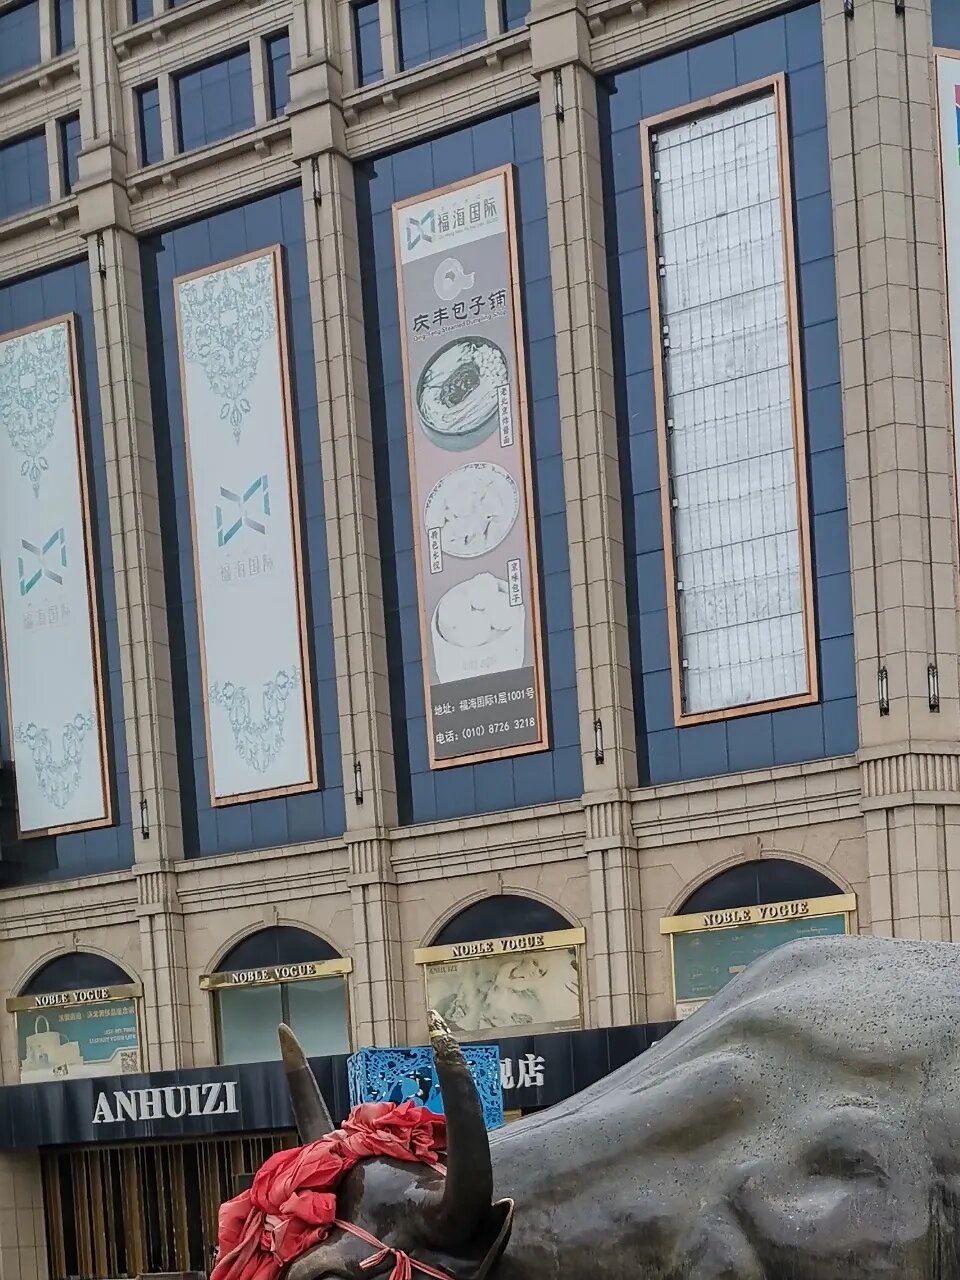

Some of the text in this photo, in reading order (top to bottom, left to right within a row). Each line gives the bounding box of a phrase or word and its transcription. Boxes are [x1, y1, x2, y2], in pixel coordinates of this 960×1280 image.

[438, 197, 497, 233] 福海国际
[413, 289, 506, 333] 庆丰包子铺
[488, 721, 510, 734] 8726
[514, 717, 535, 730] 3218
[703, 901, 809, 927] NOBLE VOGUE
[452, 935, 544, 957] NOBLE VOGUE
[232, 963, 317, 983] NOBLE VOGUE
[35, 988, 109, 1007] NOBLE VOGUE
[92, 1081, 240, 1124] ANHUIZI
